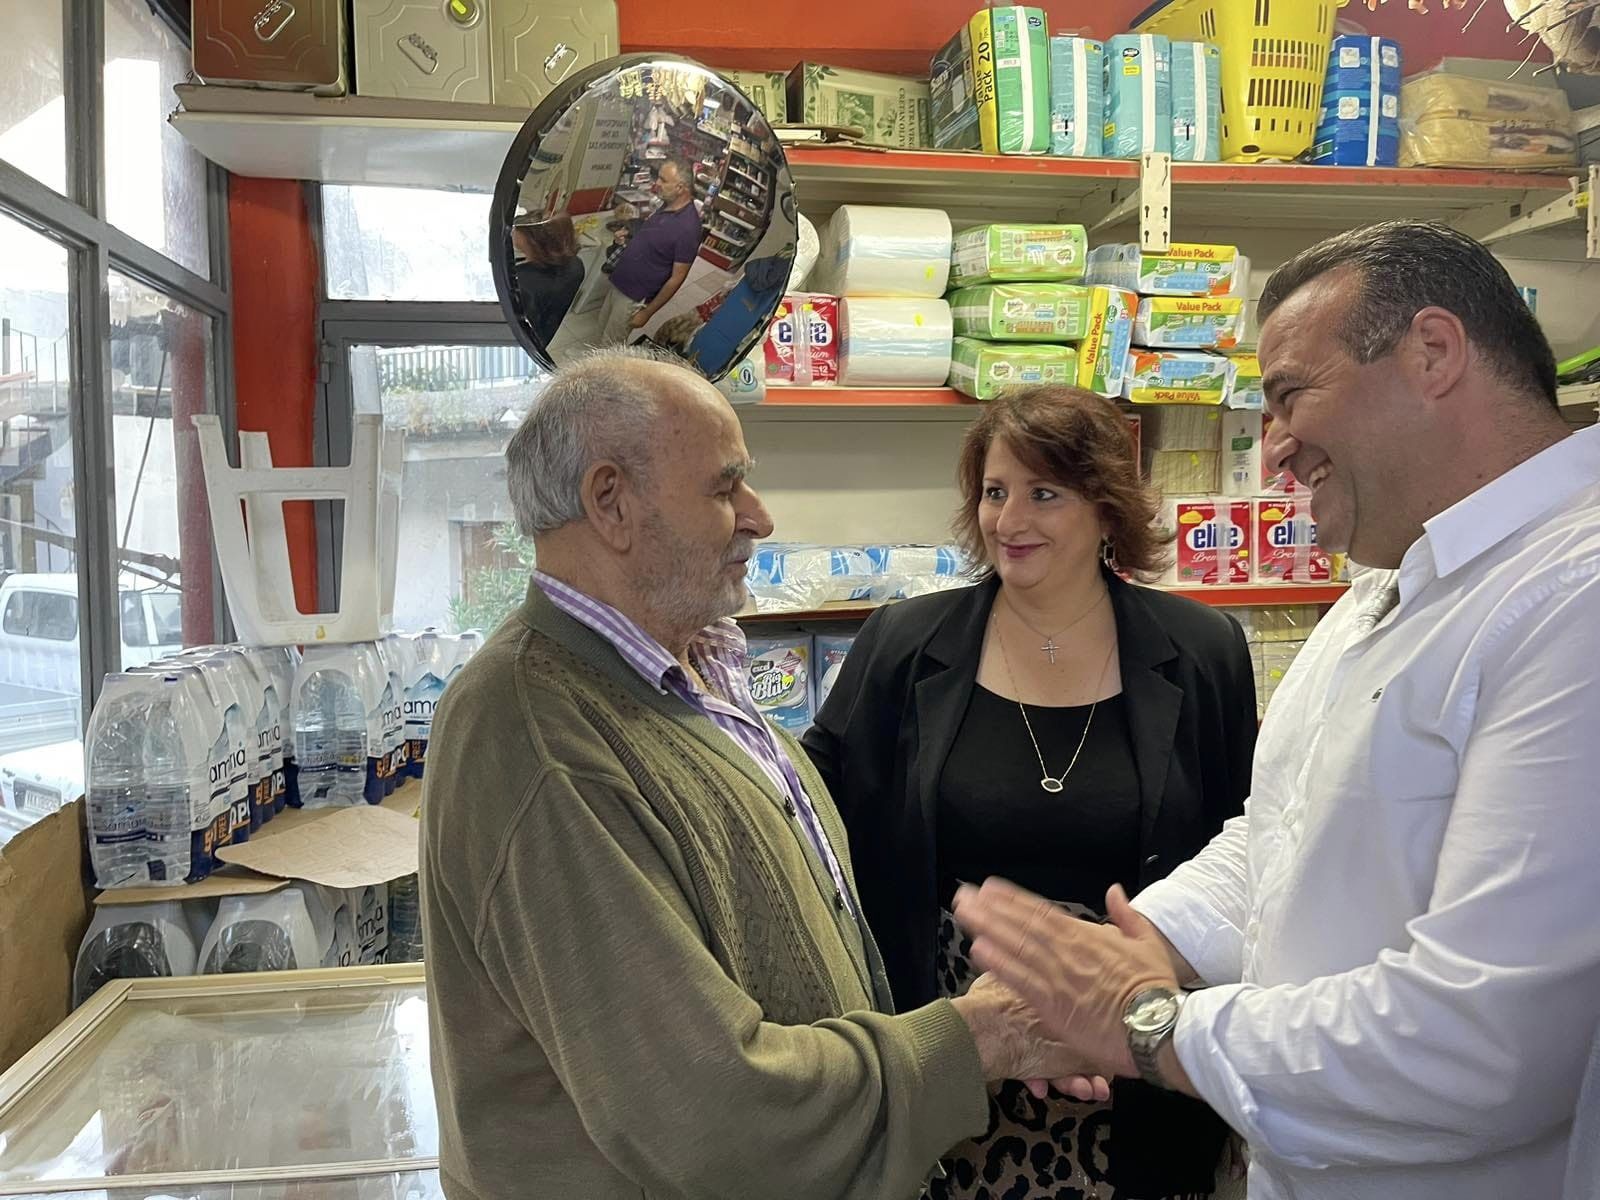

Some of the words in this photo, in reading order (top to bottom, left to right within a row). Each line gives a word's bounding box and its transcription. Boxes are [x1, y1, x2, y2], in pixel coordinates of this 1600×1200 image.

[977, 41, 990, 66] 20
[974, 70, 984, 110] Value
[983, 71, 993, 103] Pack
[1168, 248, 1192, 258] Value
[1194, 249, 1215, 258] Pack
[1176, 302, 1201, 311] Value
[1202, 303, 1222, 312] Pack
[1091, 313, 1103, 336] Pack
[1086, 337, 1099, 365] Value
[1153, 391, 1175, 400] Pack
[1176, 391, 1200, 401] Value
[762, 672, 782, 684] Big
